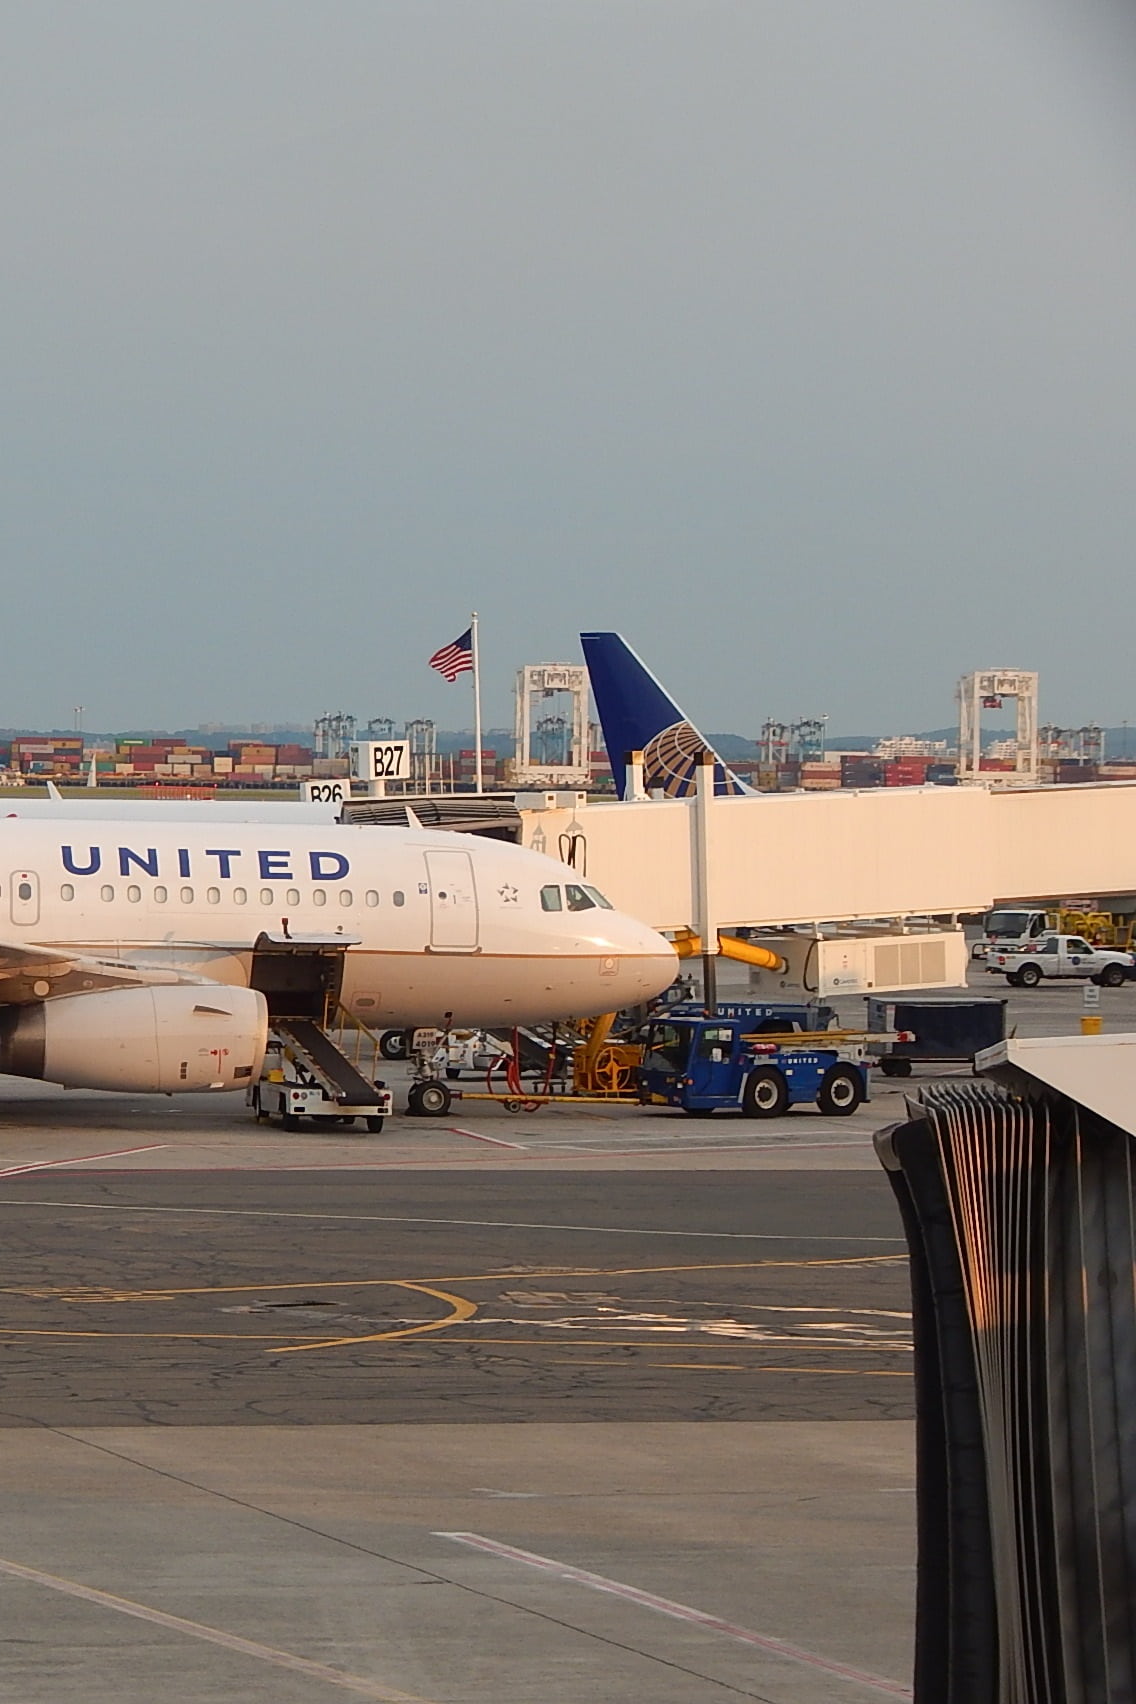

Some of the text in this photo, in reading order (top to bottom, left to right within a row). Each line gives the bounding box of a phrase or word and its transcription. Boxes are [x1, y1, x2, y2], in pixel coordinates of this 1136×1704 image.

[374, 746, 404, 777] B27
[311, 784, 343, 802] B26
[61, 846, 350, 880] UNITED
[717, 1007, 773, 1017] UNITED
